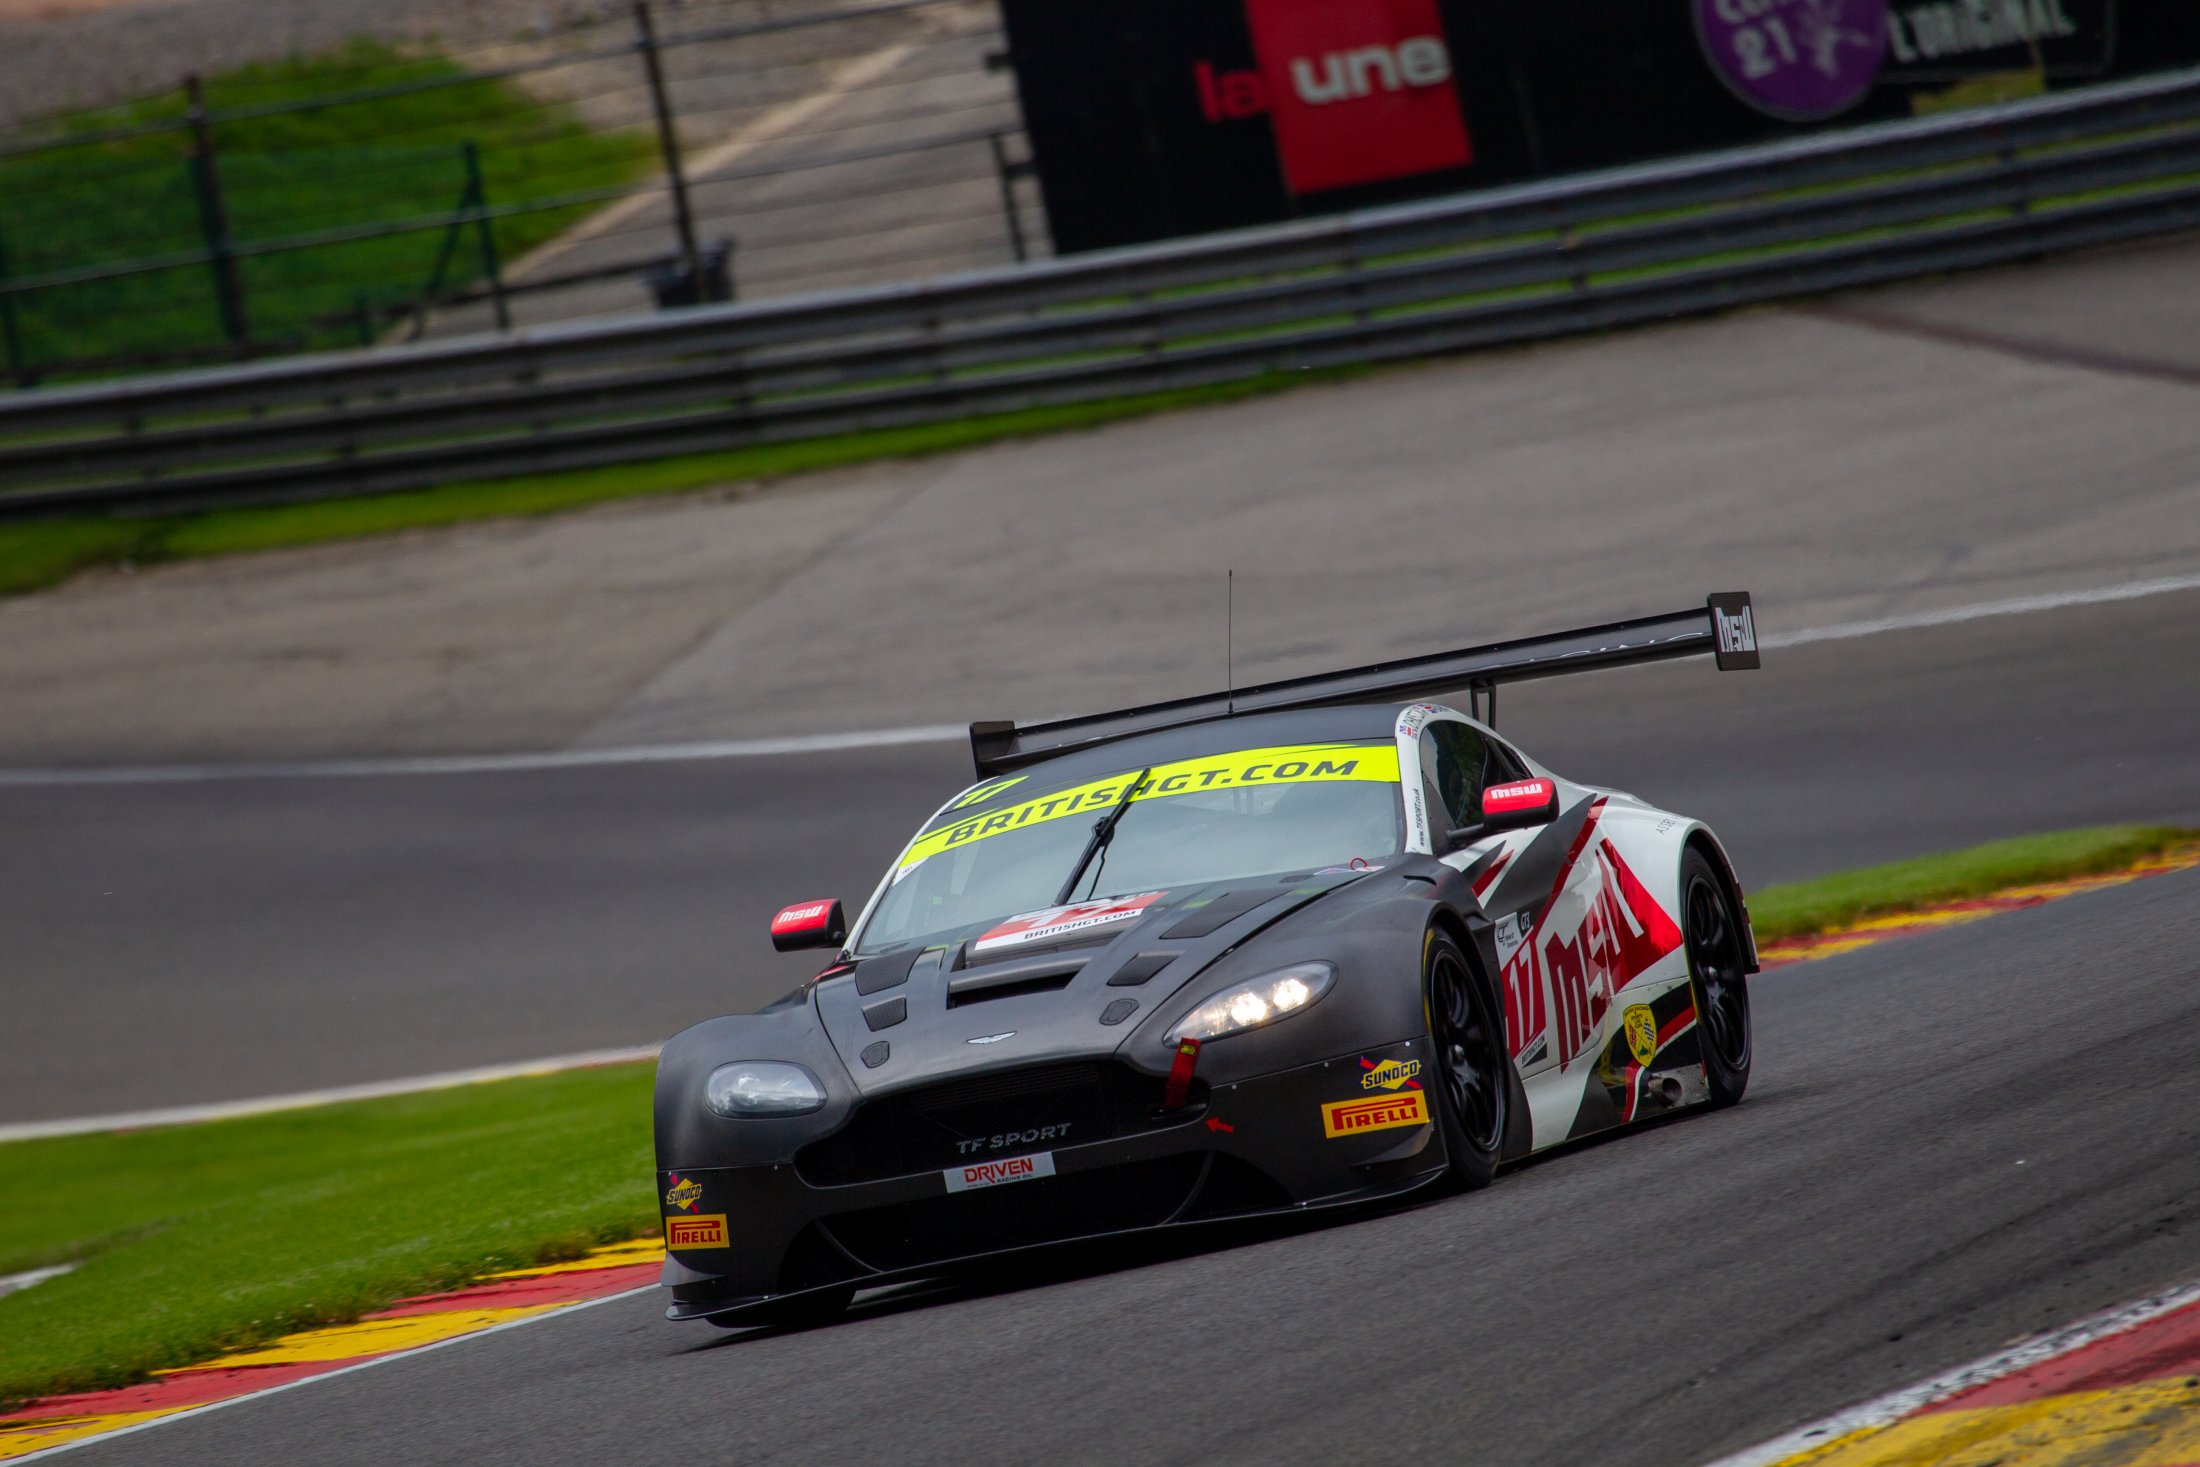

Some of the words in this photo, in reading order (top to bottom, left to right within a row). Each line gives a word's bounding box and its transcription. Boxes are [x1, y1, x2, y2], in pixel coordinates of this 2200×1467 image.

[1292, 35, 1450, 104] une
[943, 760, 1359, 847] BRITISHGT.COM
[1023, 911, 1137, 940] BRITISHGT.COM
[1509, 940, 1534, 1050] 17
[1365, 1061, 1418, 1087] SUNOCO
[1331, 1097, 1419, 1131] PIRELLI
[956, 1136, 987, 1154] TF
[989, 1122, 1072, 1149] SPORT
[963, 1158, 1034, 1184] DRIVEN
[668, 1186, 701, 1202] SUNOCO
[670, 1220, 722, 1245] PIRELLI
